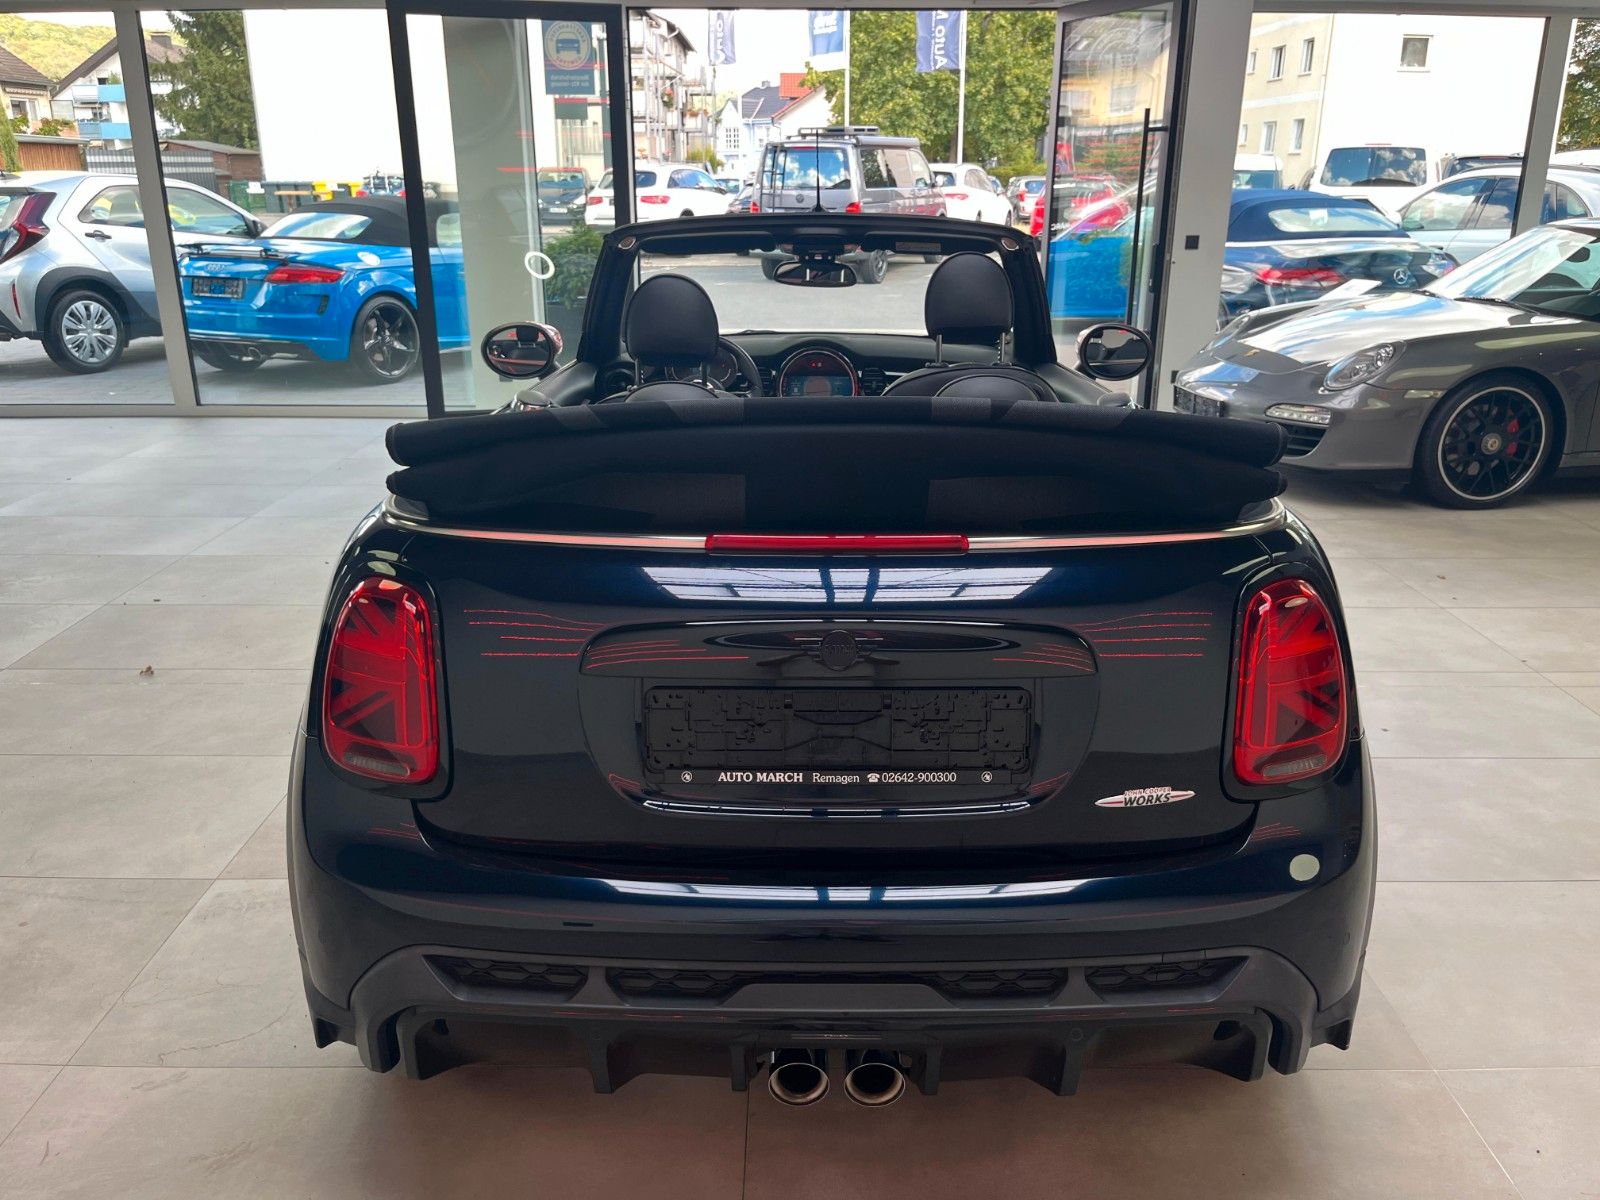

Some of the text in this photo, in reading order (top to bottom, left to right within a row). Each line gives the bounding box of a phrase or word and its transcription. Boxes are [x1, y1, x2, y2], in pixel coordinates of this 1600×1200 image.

[718, 771, 957, 785] AUTO MARCH Remagen 02642-900300
[1144, 786, 1172, 795] COOPER
[1123, 792, 1171, 807] WORKS
